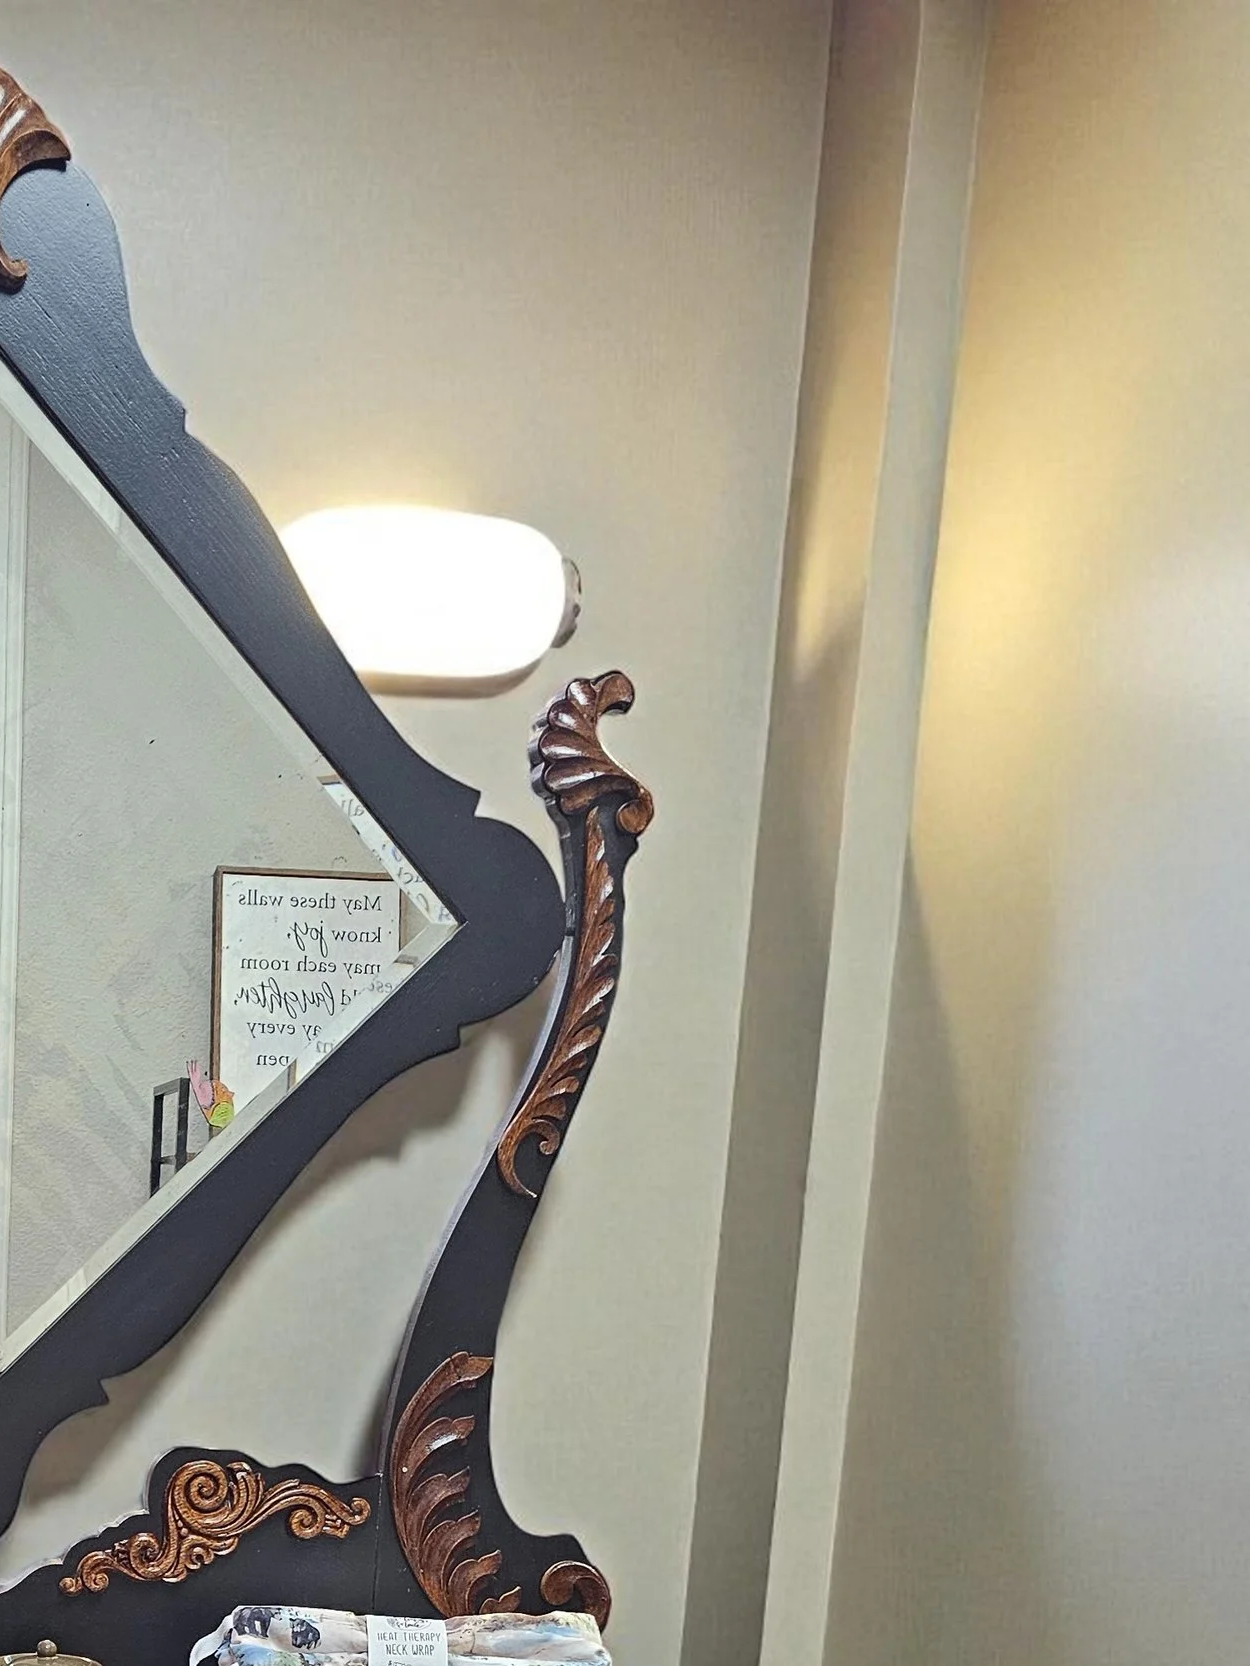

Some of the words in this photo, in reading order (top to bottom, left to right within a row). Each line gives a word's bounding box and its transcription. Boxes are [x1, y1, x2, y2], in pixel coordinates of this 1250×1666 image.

[377, 1632, 397, 1641] HEAT
[403, 1632, 441, 1642] THERAPY
[385, 1643, 408, 1656] NECK
[411, 1643, 435, 1656] WRAP
